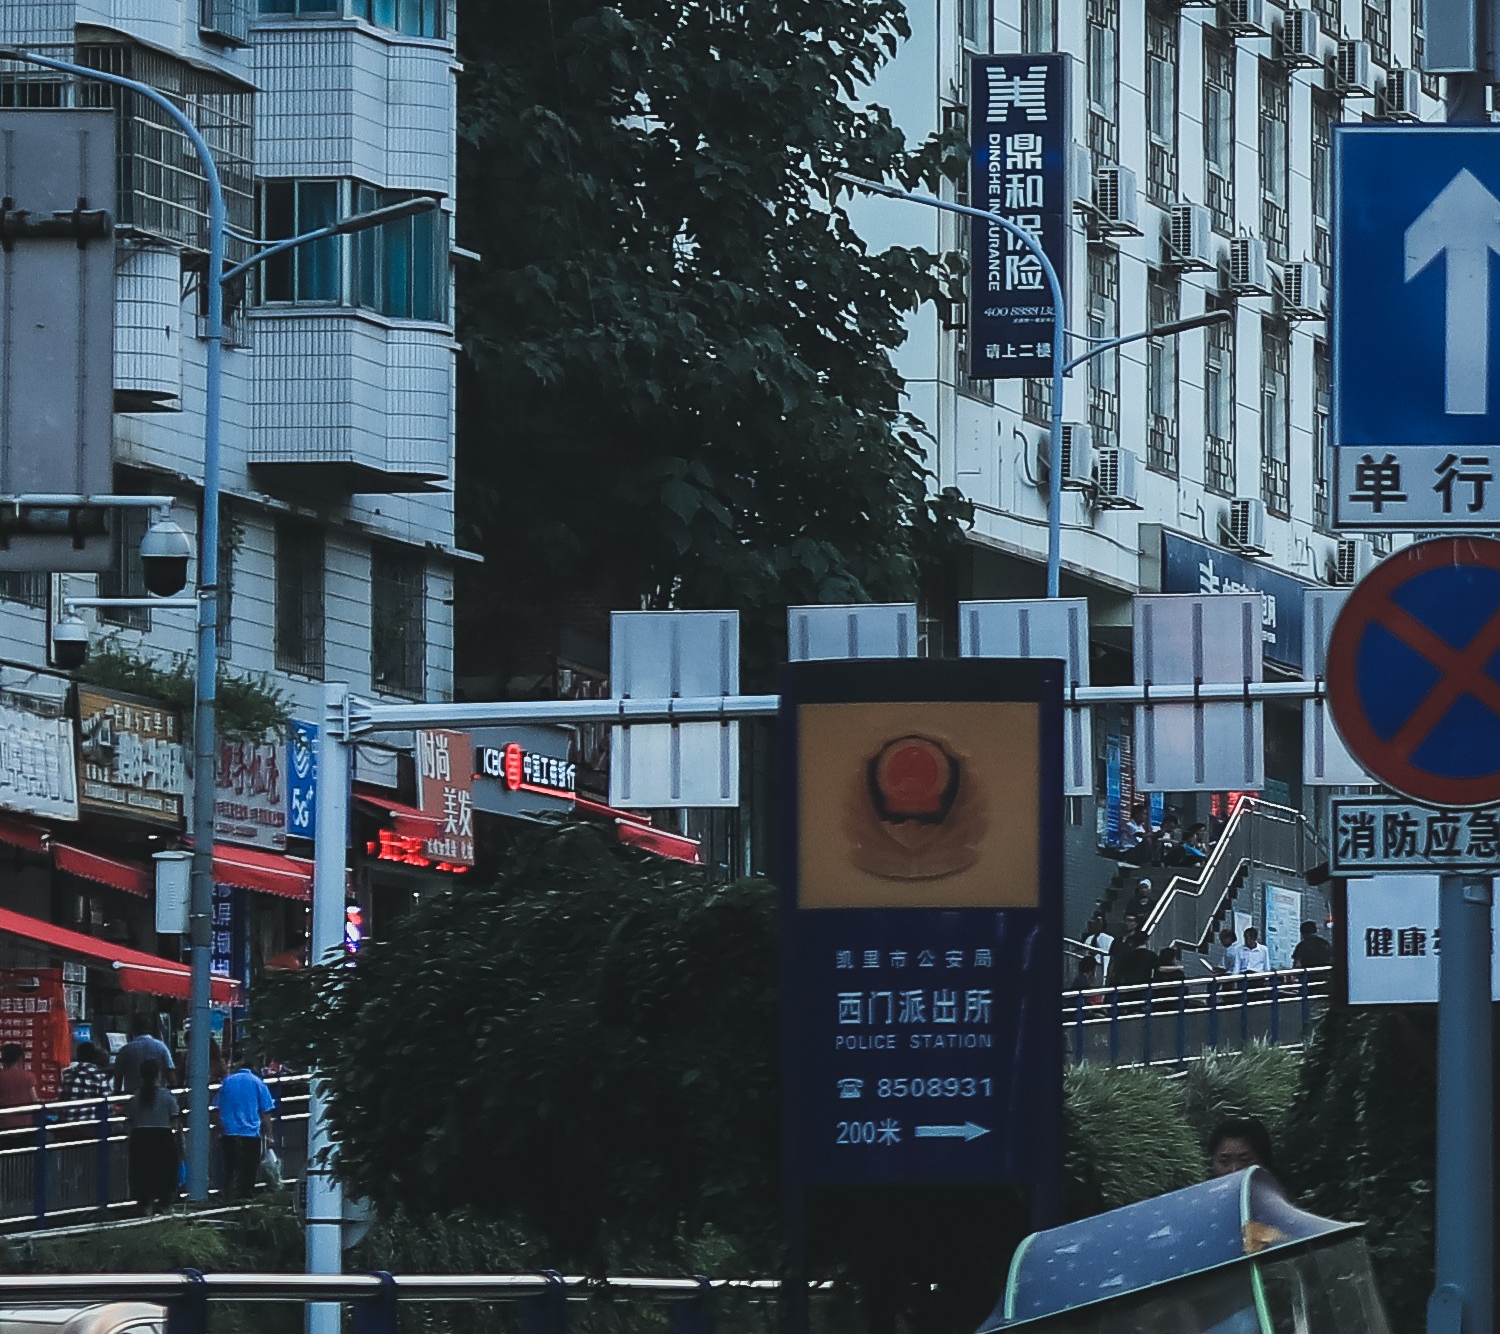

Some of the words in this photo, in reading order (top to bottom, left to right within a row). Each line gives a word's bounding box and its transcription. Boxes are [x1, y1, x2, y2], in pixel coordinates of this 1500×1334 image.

[988, 133, 1001, 195] DINGHE
[1005, 133, 1044, 291] 鼎和保险
[985, 343, 1052, 360] 请上二楼
[420, 731, 450, 782] 时尚
[483, 747, 505, 779] ICBC
[523, 752, 577, 791] 中国工商银行
[442, 787, 474, 837] 美发
[836, 948, 993, 969] 凯里市公安局
[836, 988, 994, 1025] 西门派出所
[835, 1034, 897, 1050] POLICE
[909, 1033, 993, 1049] STATION
[876, 1077, 993, 1098] 8508931
[836, 1118, 902, 1146] 200米
